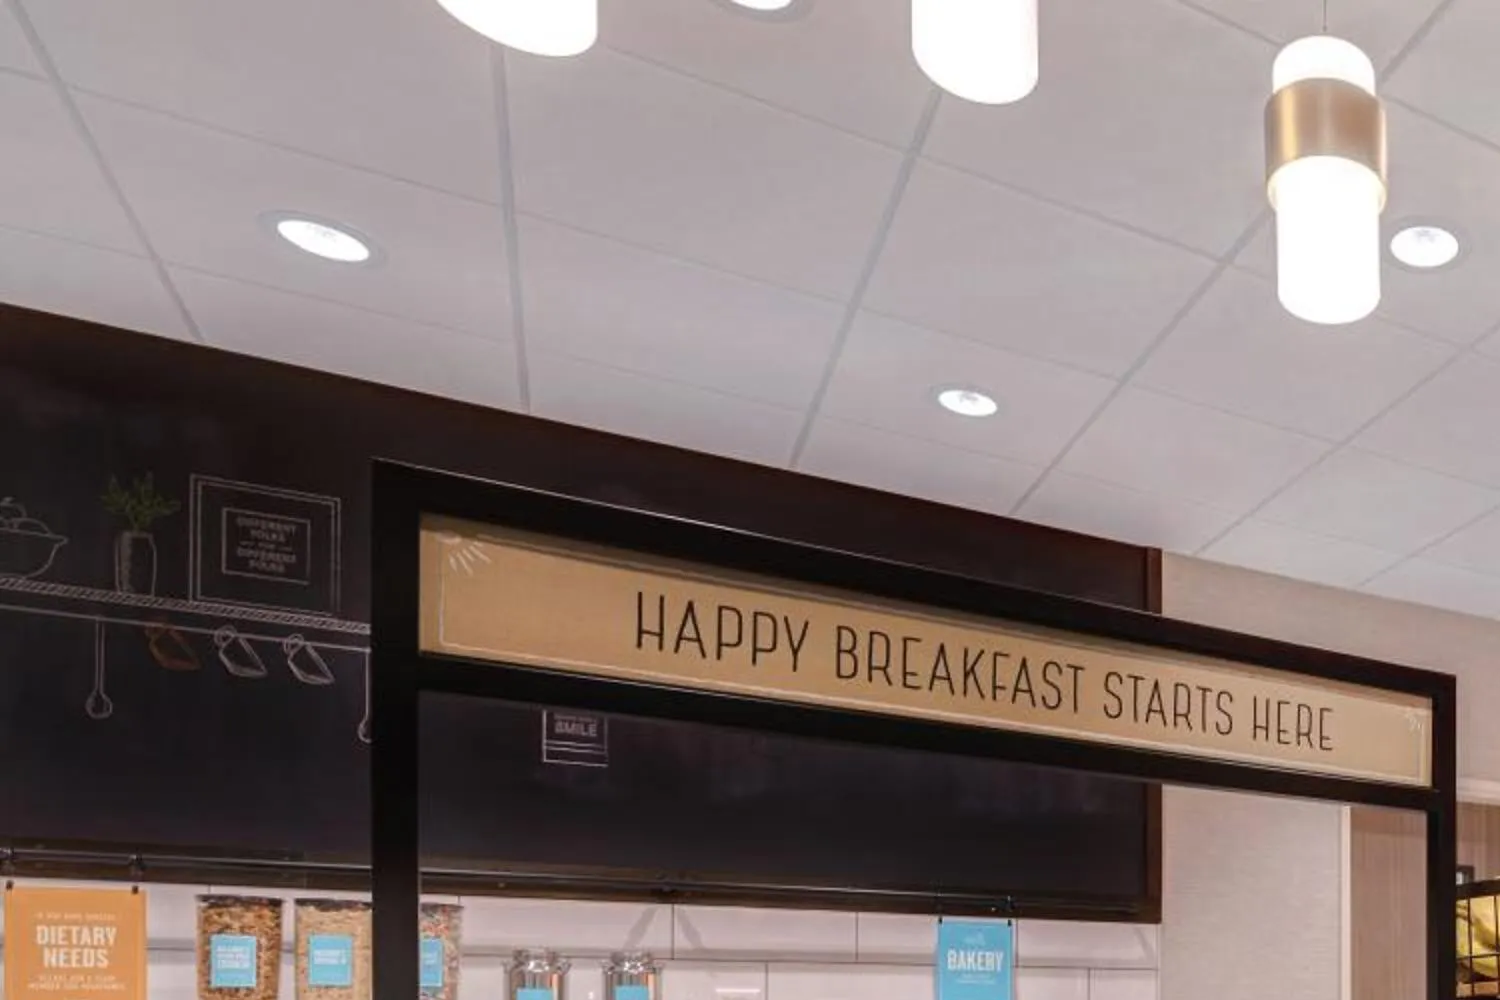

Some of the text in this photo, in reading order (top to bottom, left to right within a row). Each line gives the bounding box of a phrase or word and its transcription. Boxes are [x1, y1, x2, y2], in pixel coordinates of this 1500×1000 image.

[636, 590, 1335, 752] HAPPY BREAKFAST STARTS HERE
[36, 924, 117, 946] DIETARY
[43, 947, 109, 968] NEEDS
[946, 948, 1004, 972] BAKERY
